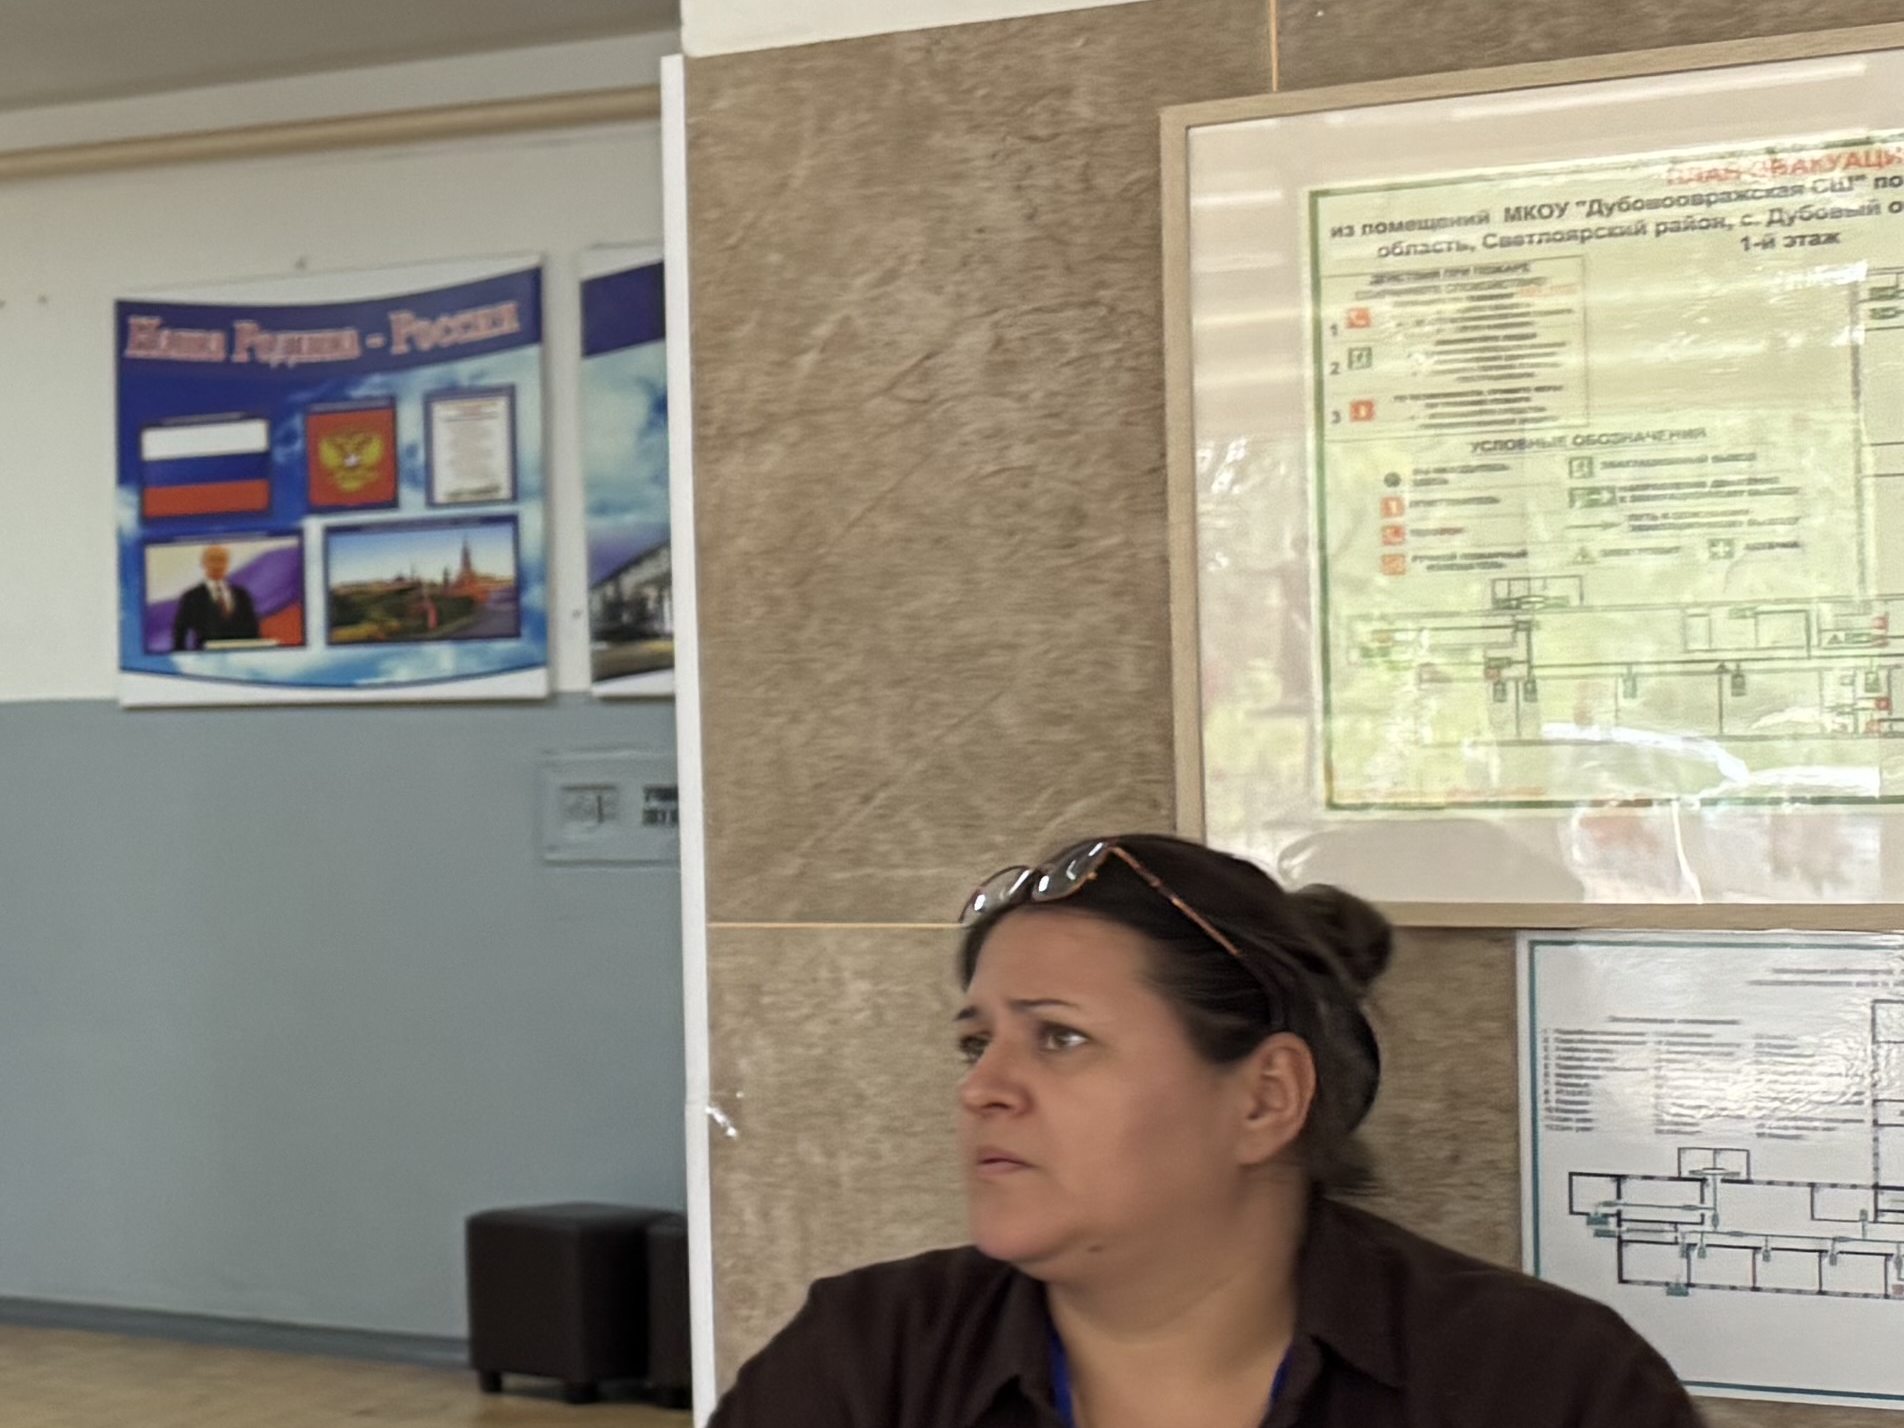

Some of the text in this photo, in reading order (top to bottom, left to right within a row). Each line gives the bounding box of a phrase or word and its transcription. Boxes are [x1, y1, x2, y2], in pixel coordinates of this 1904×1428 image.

[1331, 224, 1355, 240] из
[1361, 209, 1491, 237] помещений
[1504, 201, 1571, 223] МКОУ
[1655, 215, 1734, 239] район,
[1783, 231, 1841, 249] этаж
